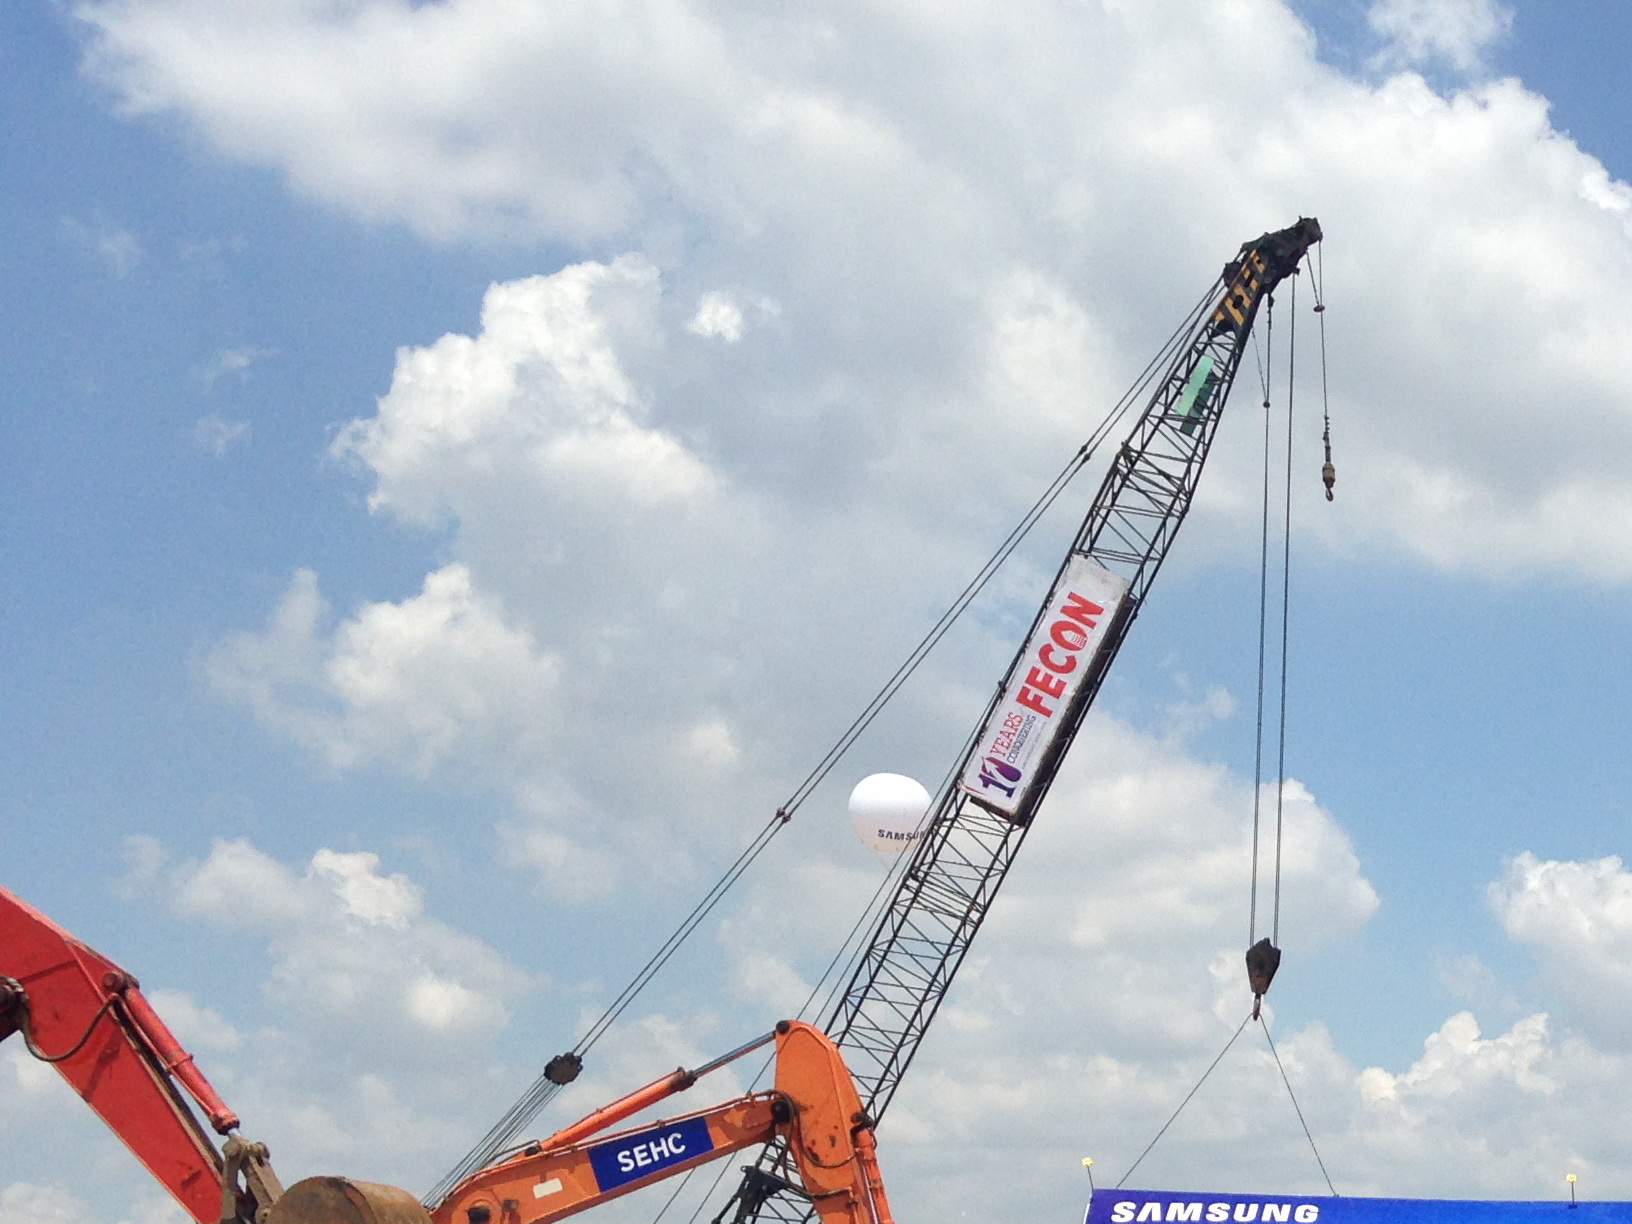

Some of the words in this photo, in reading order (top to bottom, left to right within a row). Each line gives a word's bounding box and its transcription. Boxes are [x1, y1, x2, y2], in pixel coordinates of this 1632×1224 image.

[1015, 591, 1105, 718] FECON
[990, 711, 1023, 757] YEARS
[617, 1132, 686, 1173] SEHC
[1110, 1201, 1319, 1223] SAMSUNG
